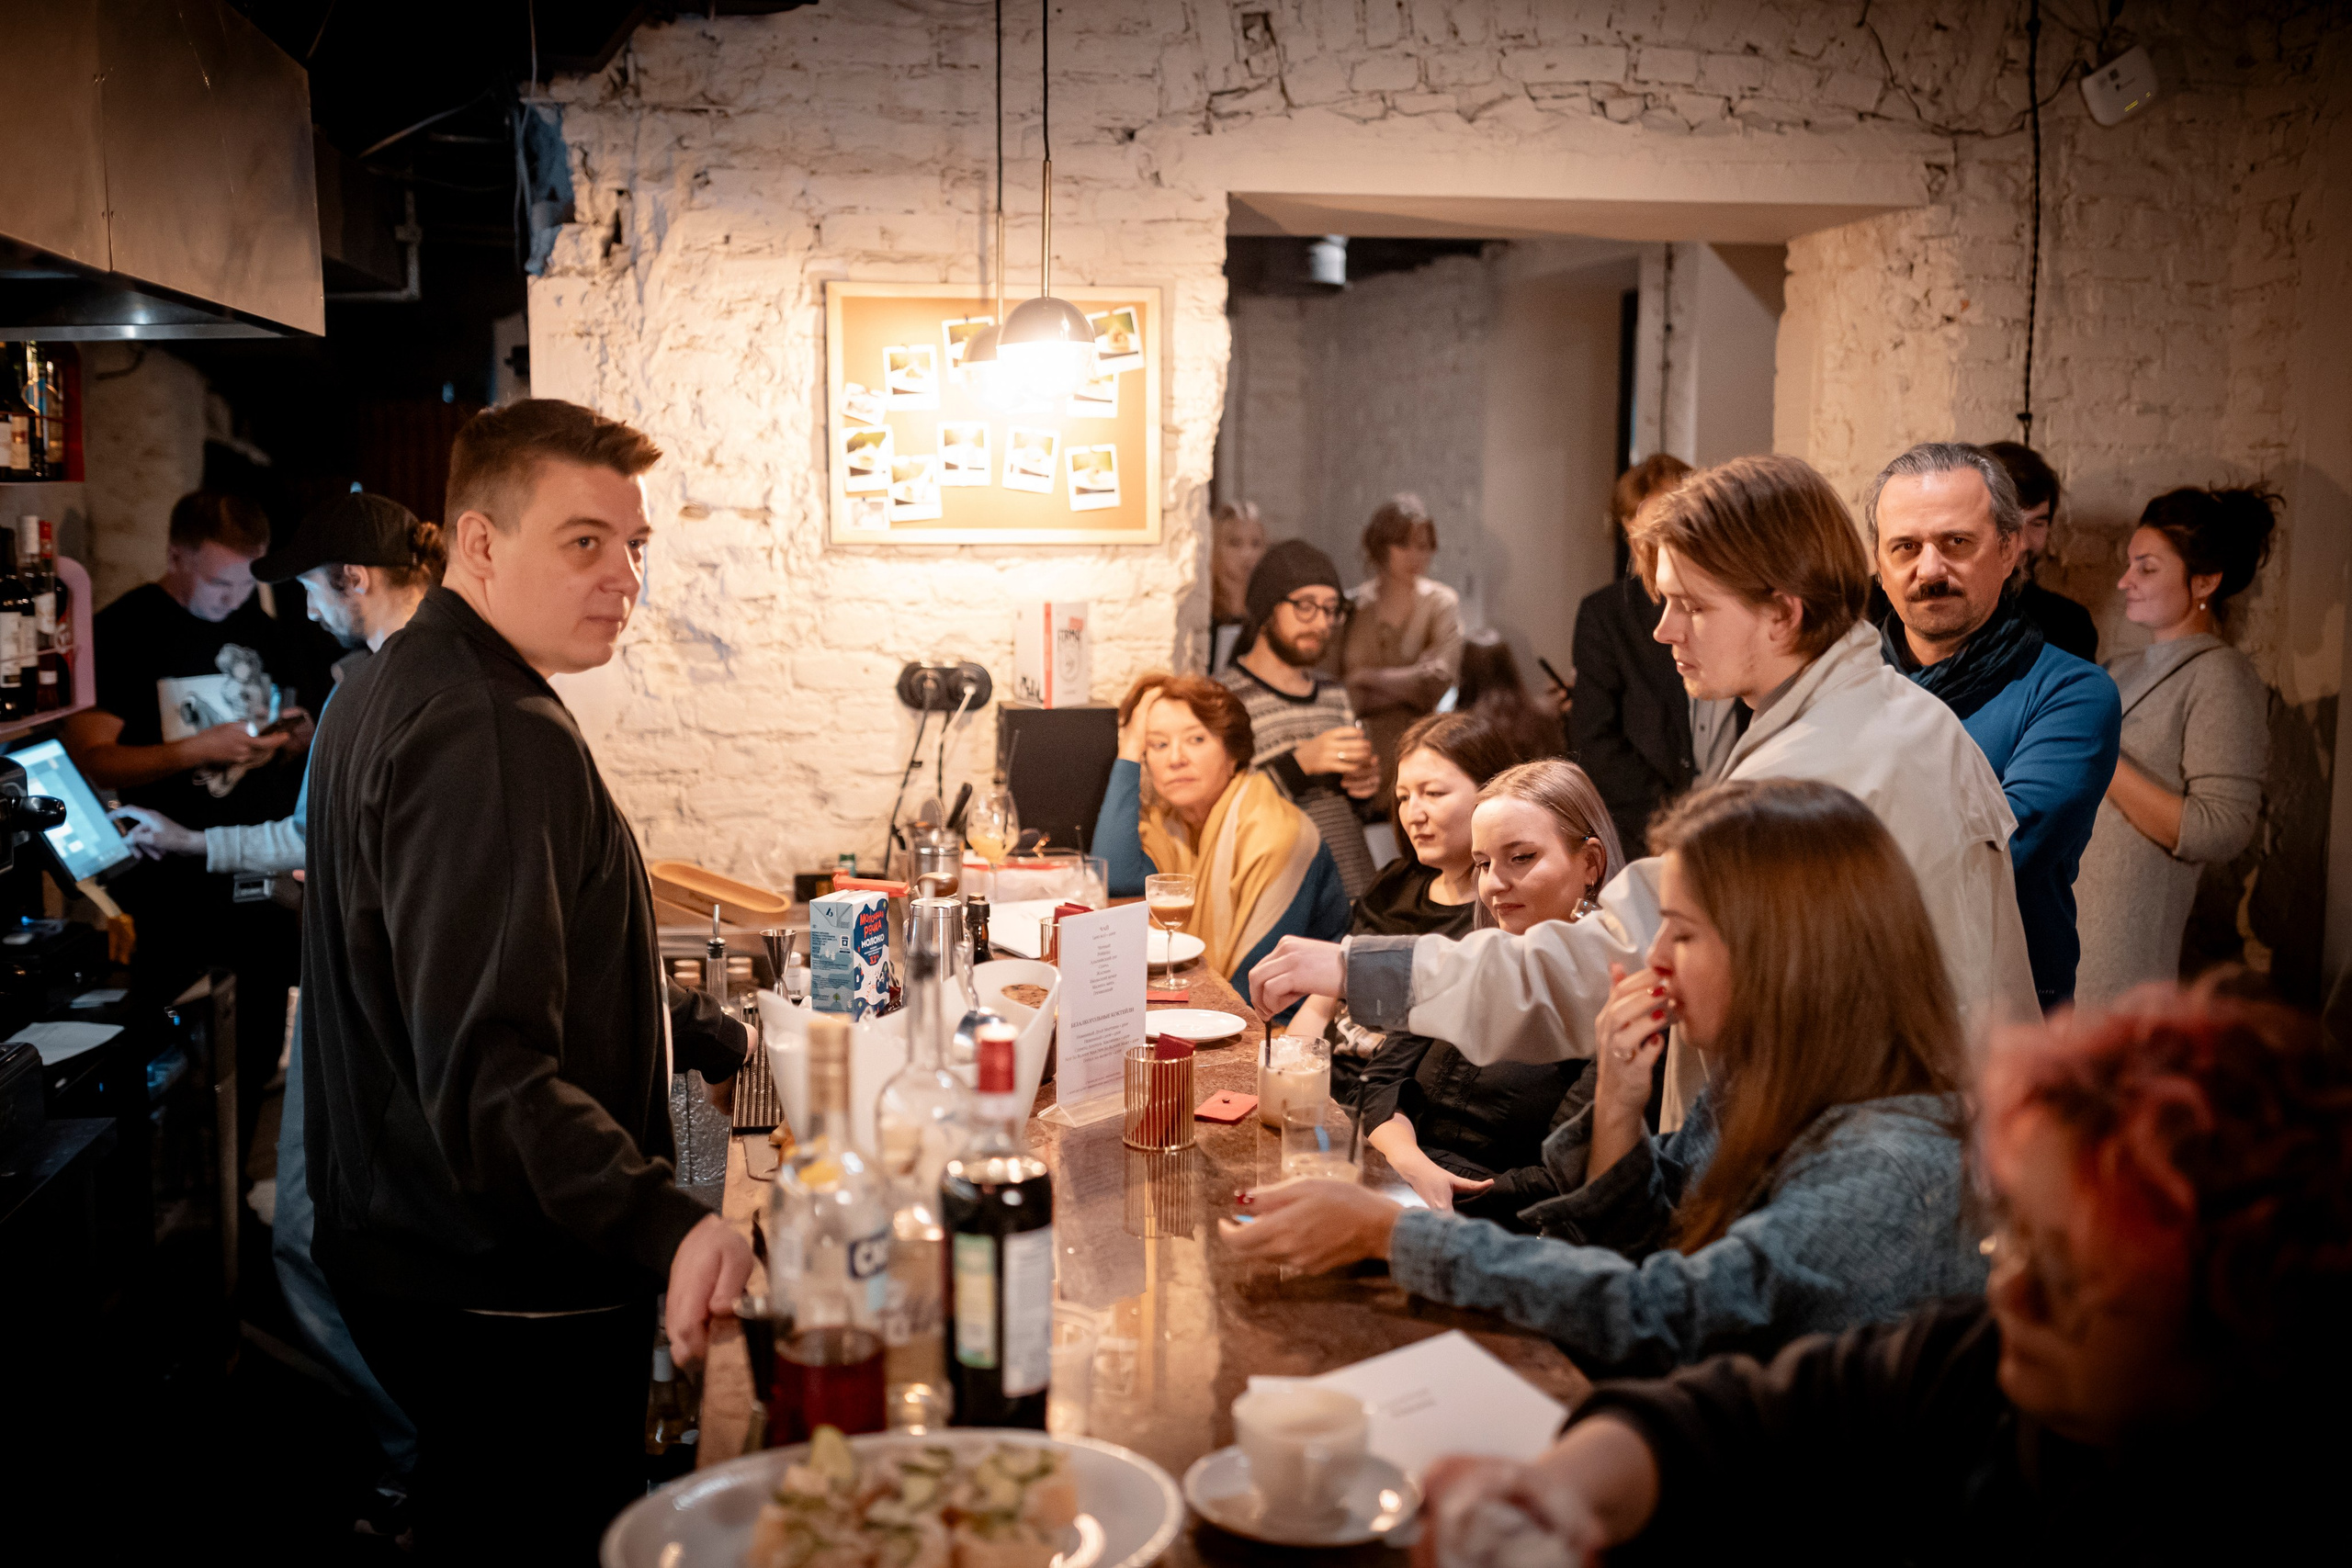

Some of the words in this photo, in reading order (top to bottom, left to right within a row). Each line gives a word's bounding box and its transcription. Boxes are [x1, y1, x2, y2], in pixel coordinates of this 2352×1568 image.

[860, 910, 884, 925] МОЛОЧНАЯ
[864, 919, 882, 939] РЕЧКА
[861, 933, 884, 948] МОЛОКО
